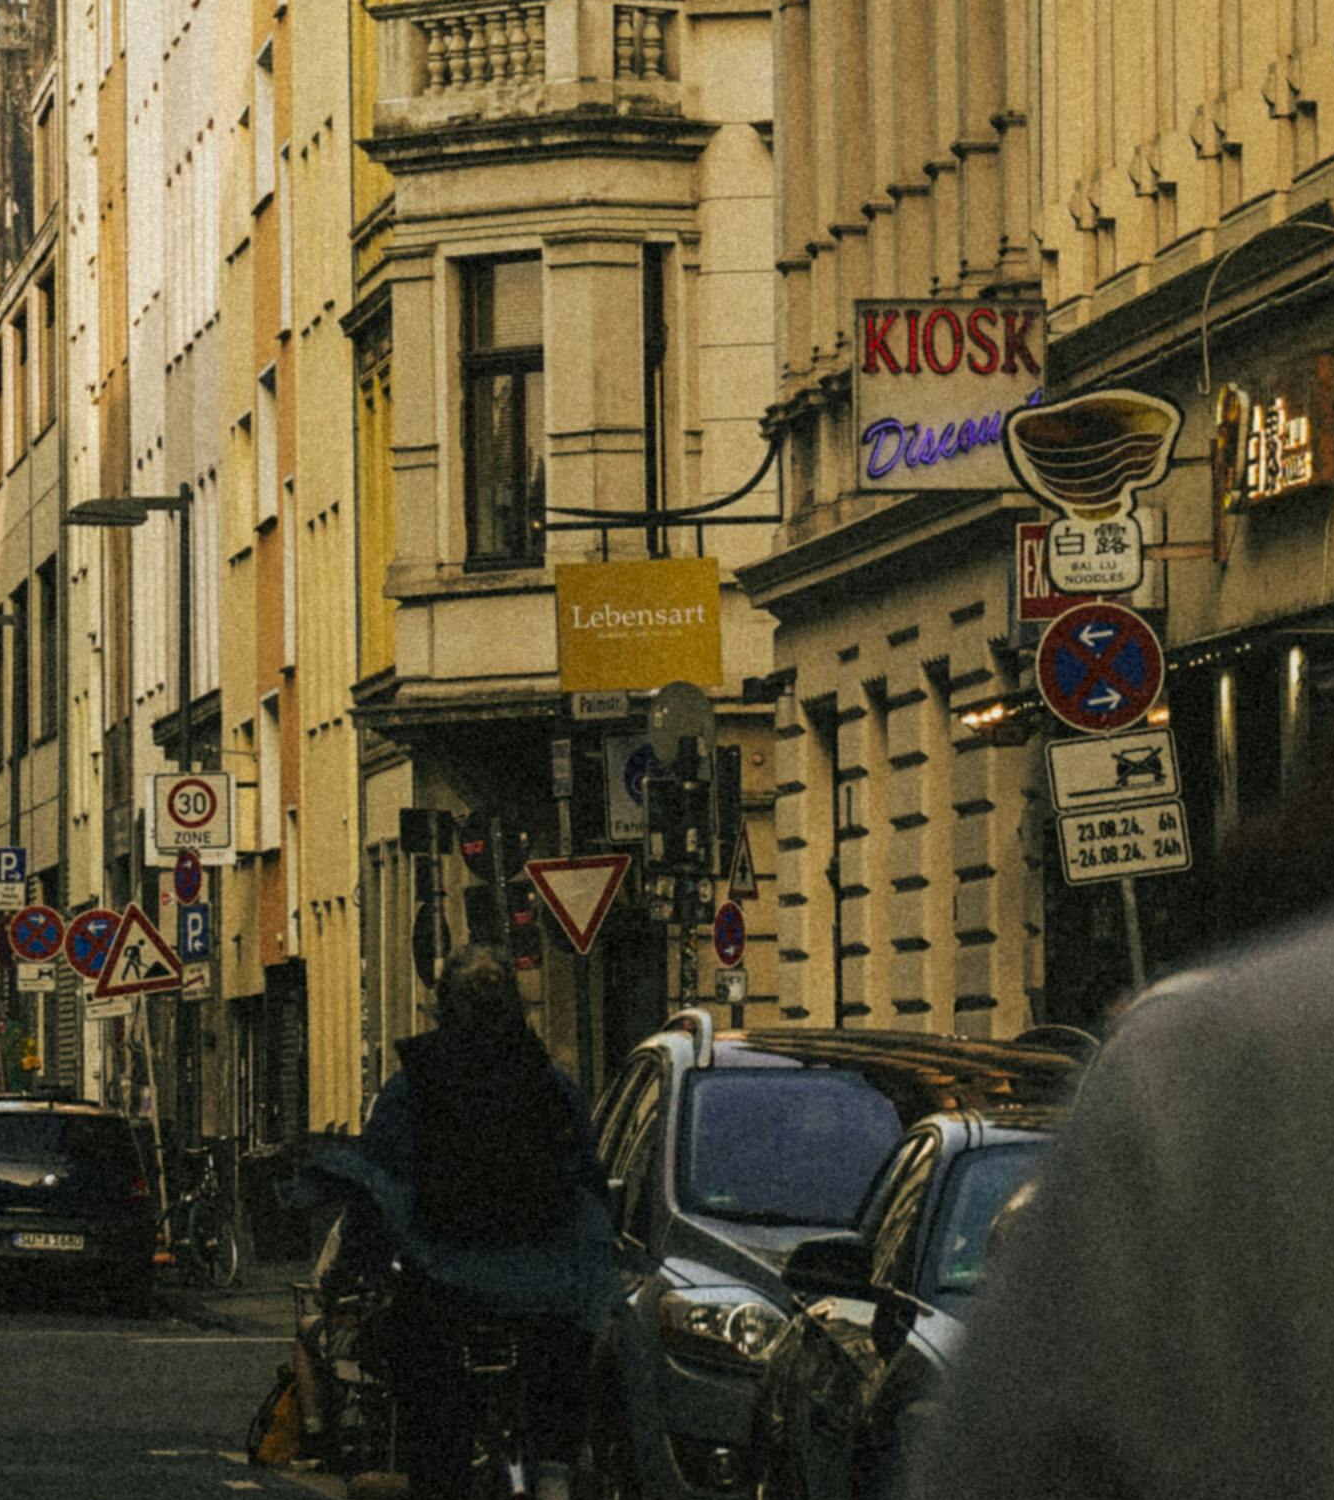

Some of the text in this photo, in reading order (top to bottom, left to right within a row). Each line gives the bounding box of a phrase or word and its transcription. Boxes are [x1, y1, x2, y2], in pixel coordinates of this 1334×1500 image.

[862, 307, 1041, 374] KIOSK
[1055, 523, 1131, 556] 白露
[1071, 561, 1116, 571] BAI LU
[1065, 572, 1125, 585] NOODLES
[572, 603, 706, 630] Lebensart
[178, 792, 206, 815] 30
[1159, 811, 1176, 831] 6h
[174, 831, 211, 844] ZONE
[1155, 838, 1181, 858] 24h
